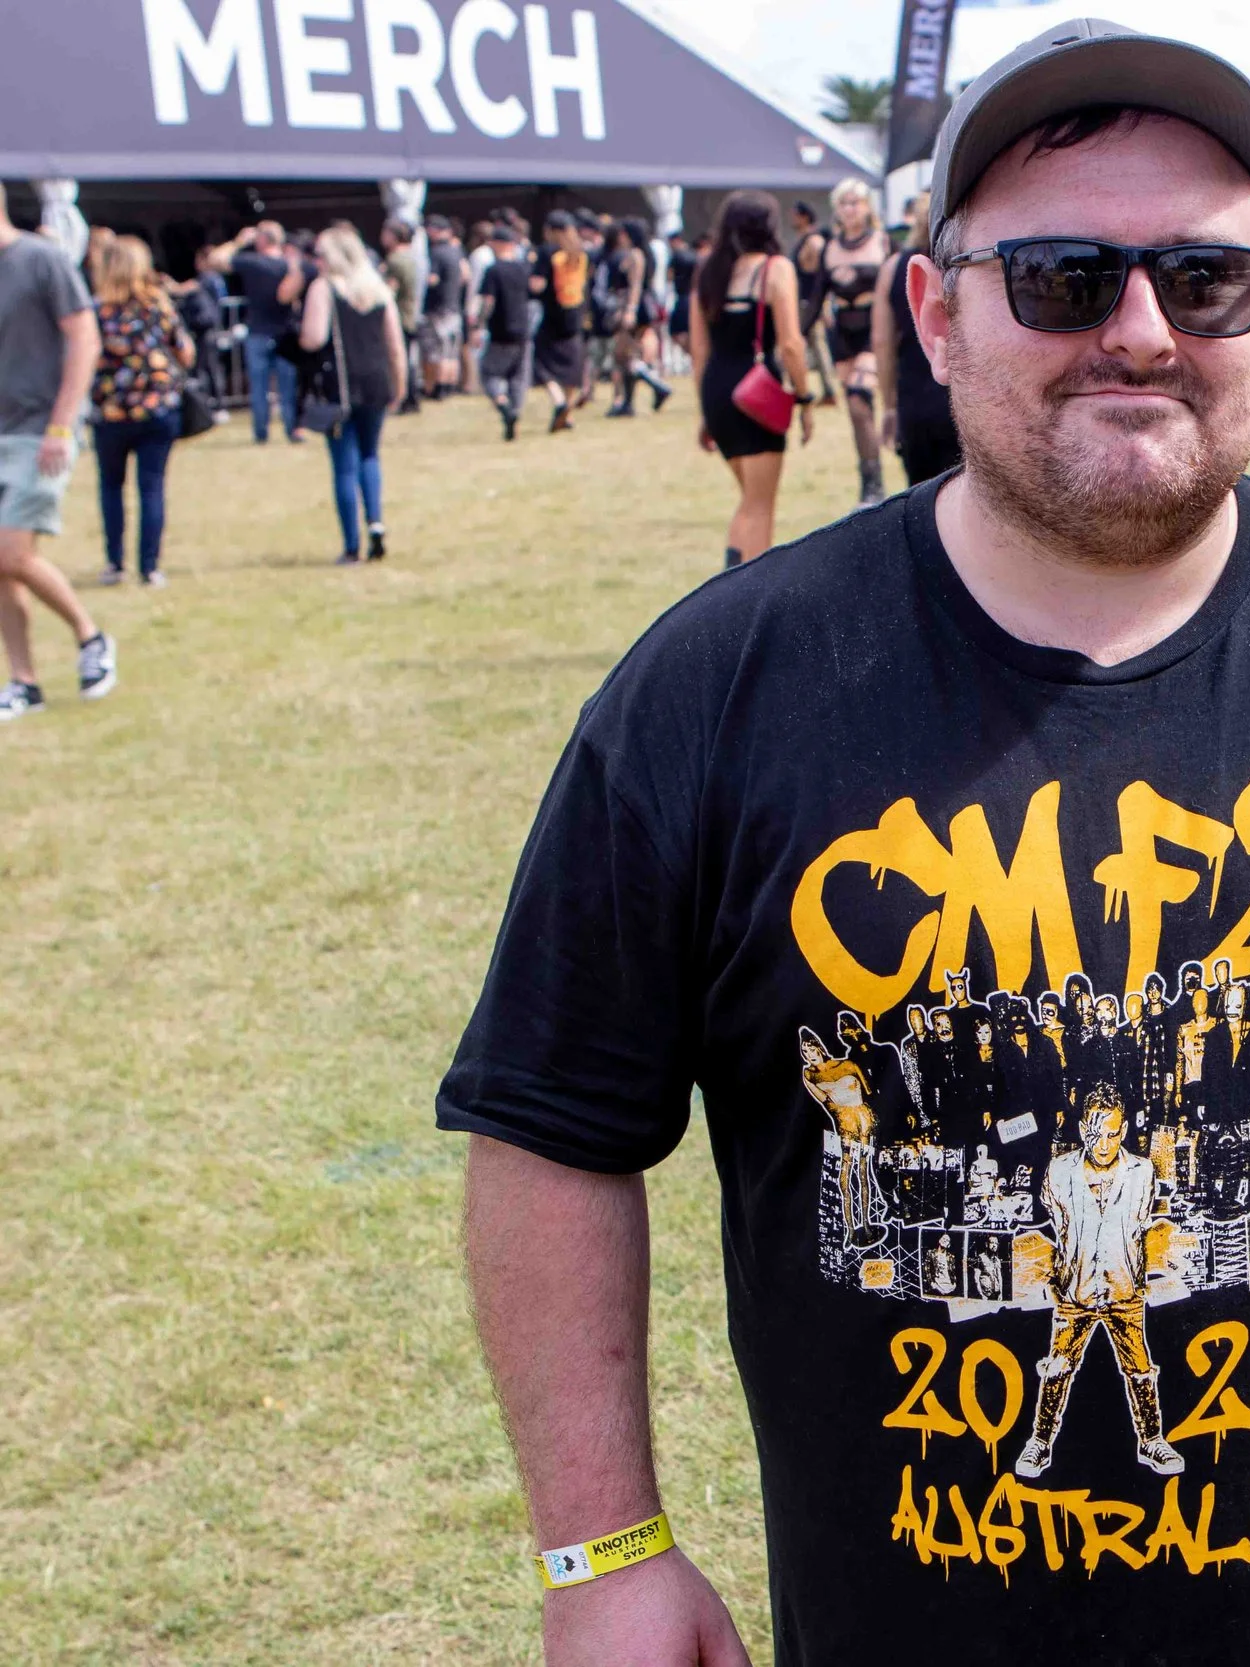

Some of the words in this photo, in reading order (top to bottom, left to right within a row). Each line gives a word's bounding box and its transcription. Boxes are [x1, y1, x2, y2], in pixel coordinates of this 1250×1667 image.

[142, 0, 606, 139] MERCH
[882, 1327, 1024, 1475] 20
[592, 1520, 661, 1556] KNOTFEST
[604, 1534, 659, 1558] AUSTRALIA
[550, 1553, 568, 1580] AAC
[623, 1547, 647, 1561] SYD
